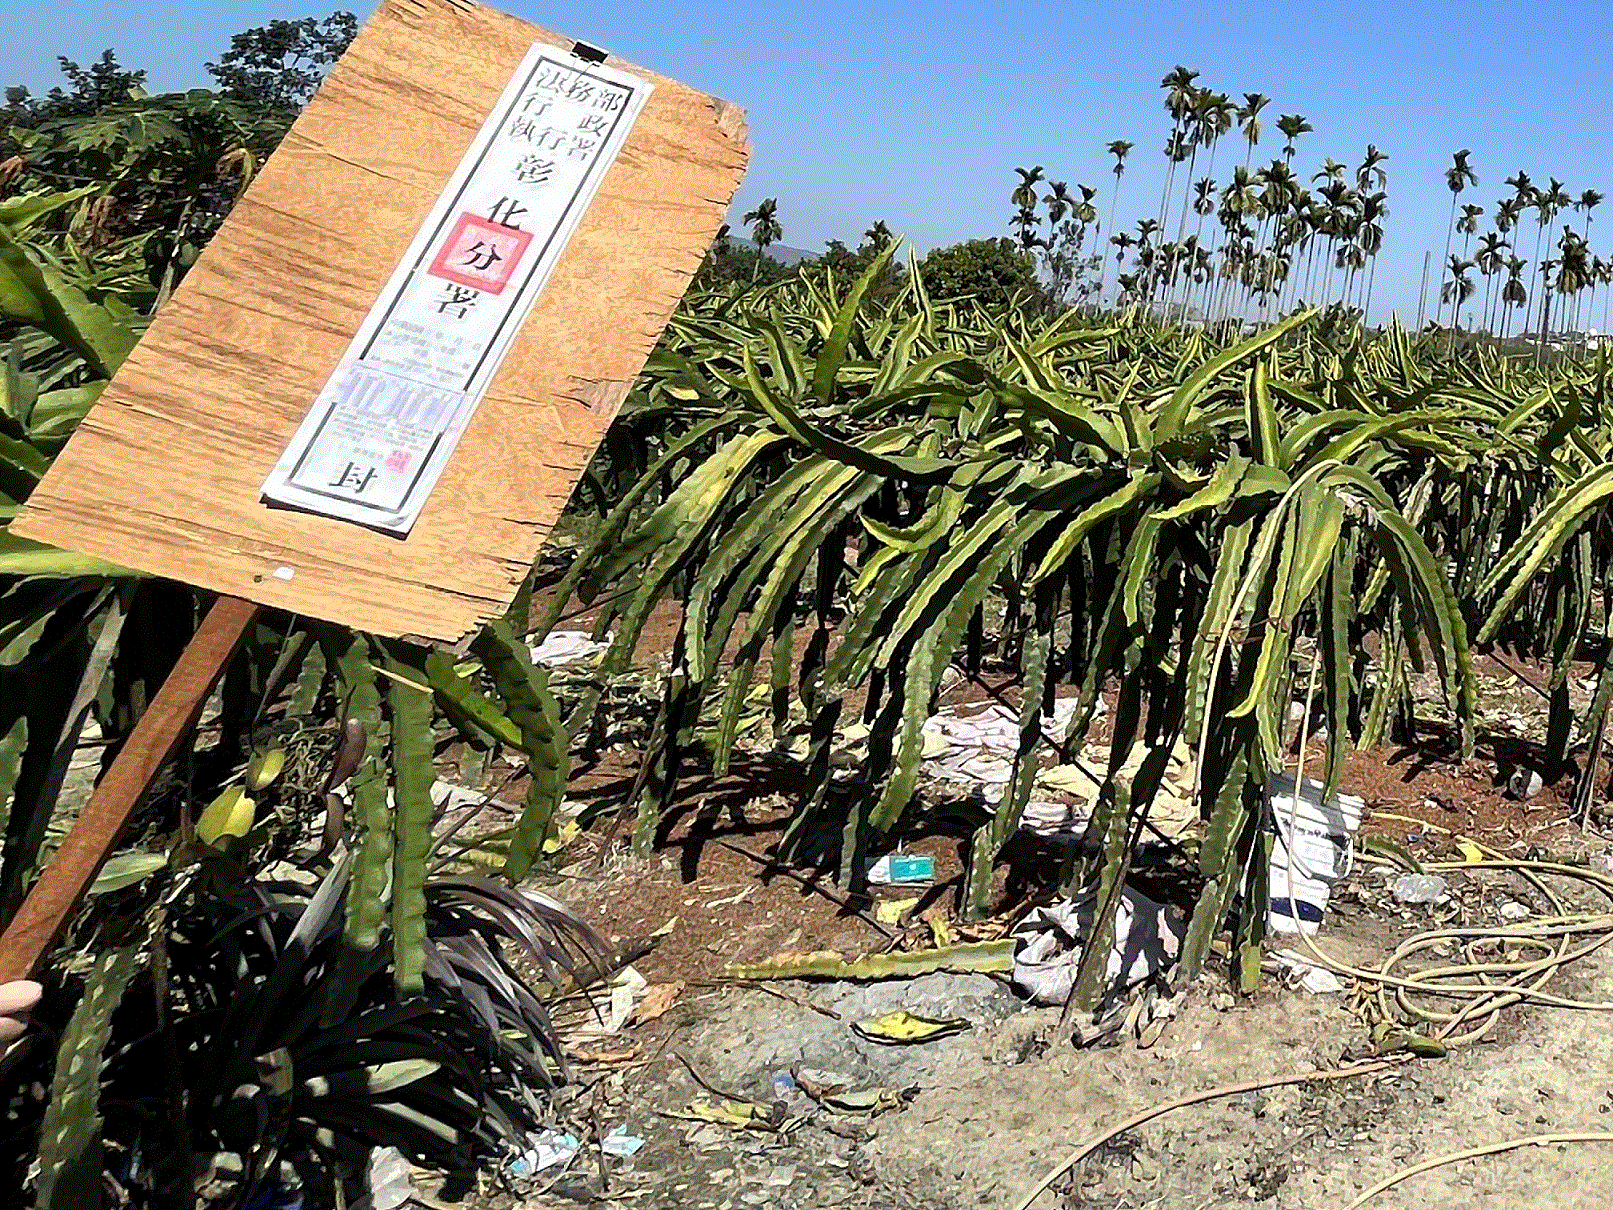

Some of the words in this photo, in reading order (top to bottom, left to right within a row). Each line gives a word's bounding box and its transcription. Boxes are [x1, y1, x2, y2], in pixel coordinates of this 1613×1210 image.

[535, 68, 623, 112] 法務部
[508, 115, 597, 162] 執行署
[328, 461, 379, 494] 封
